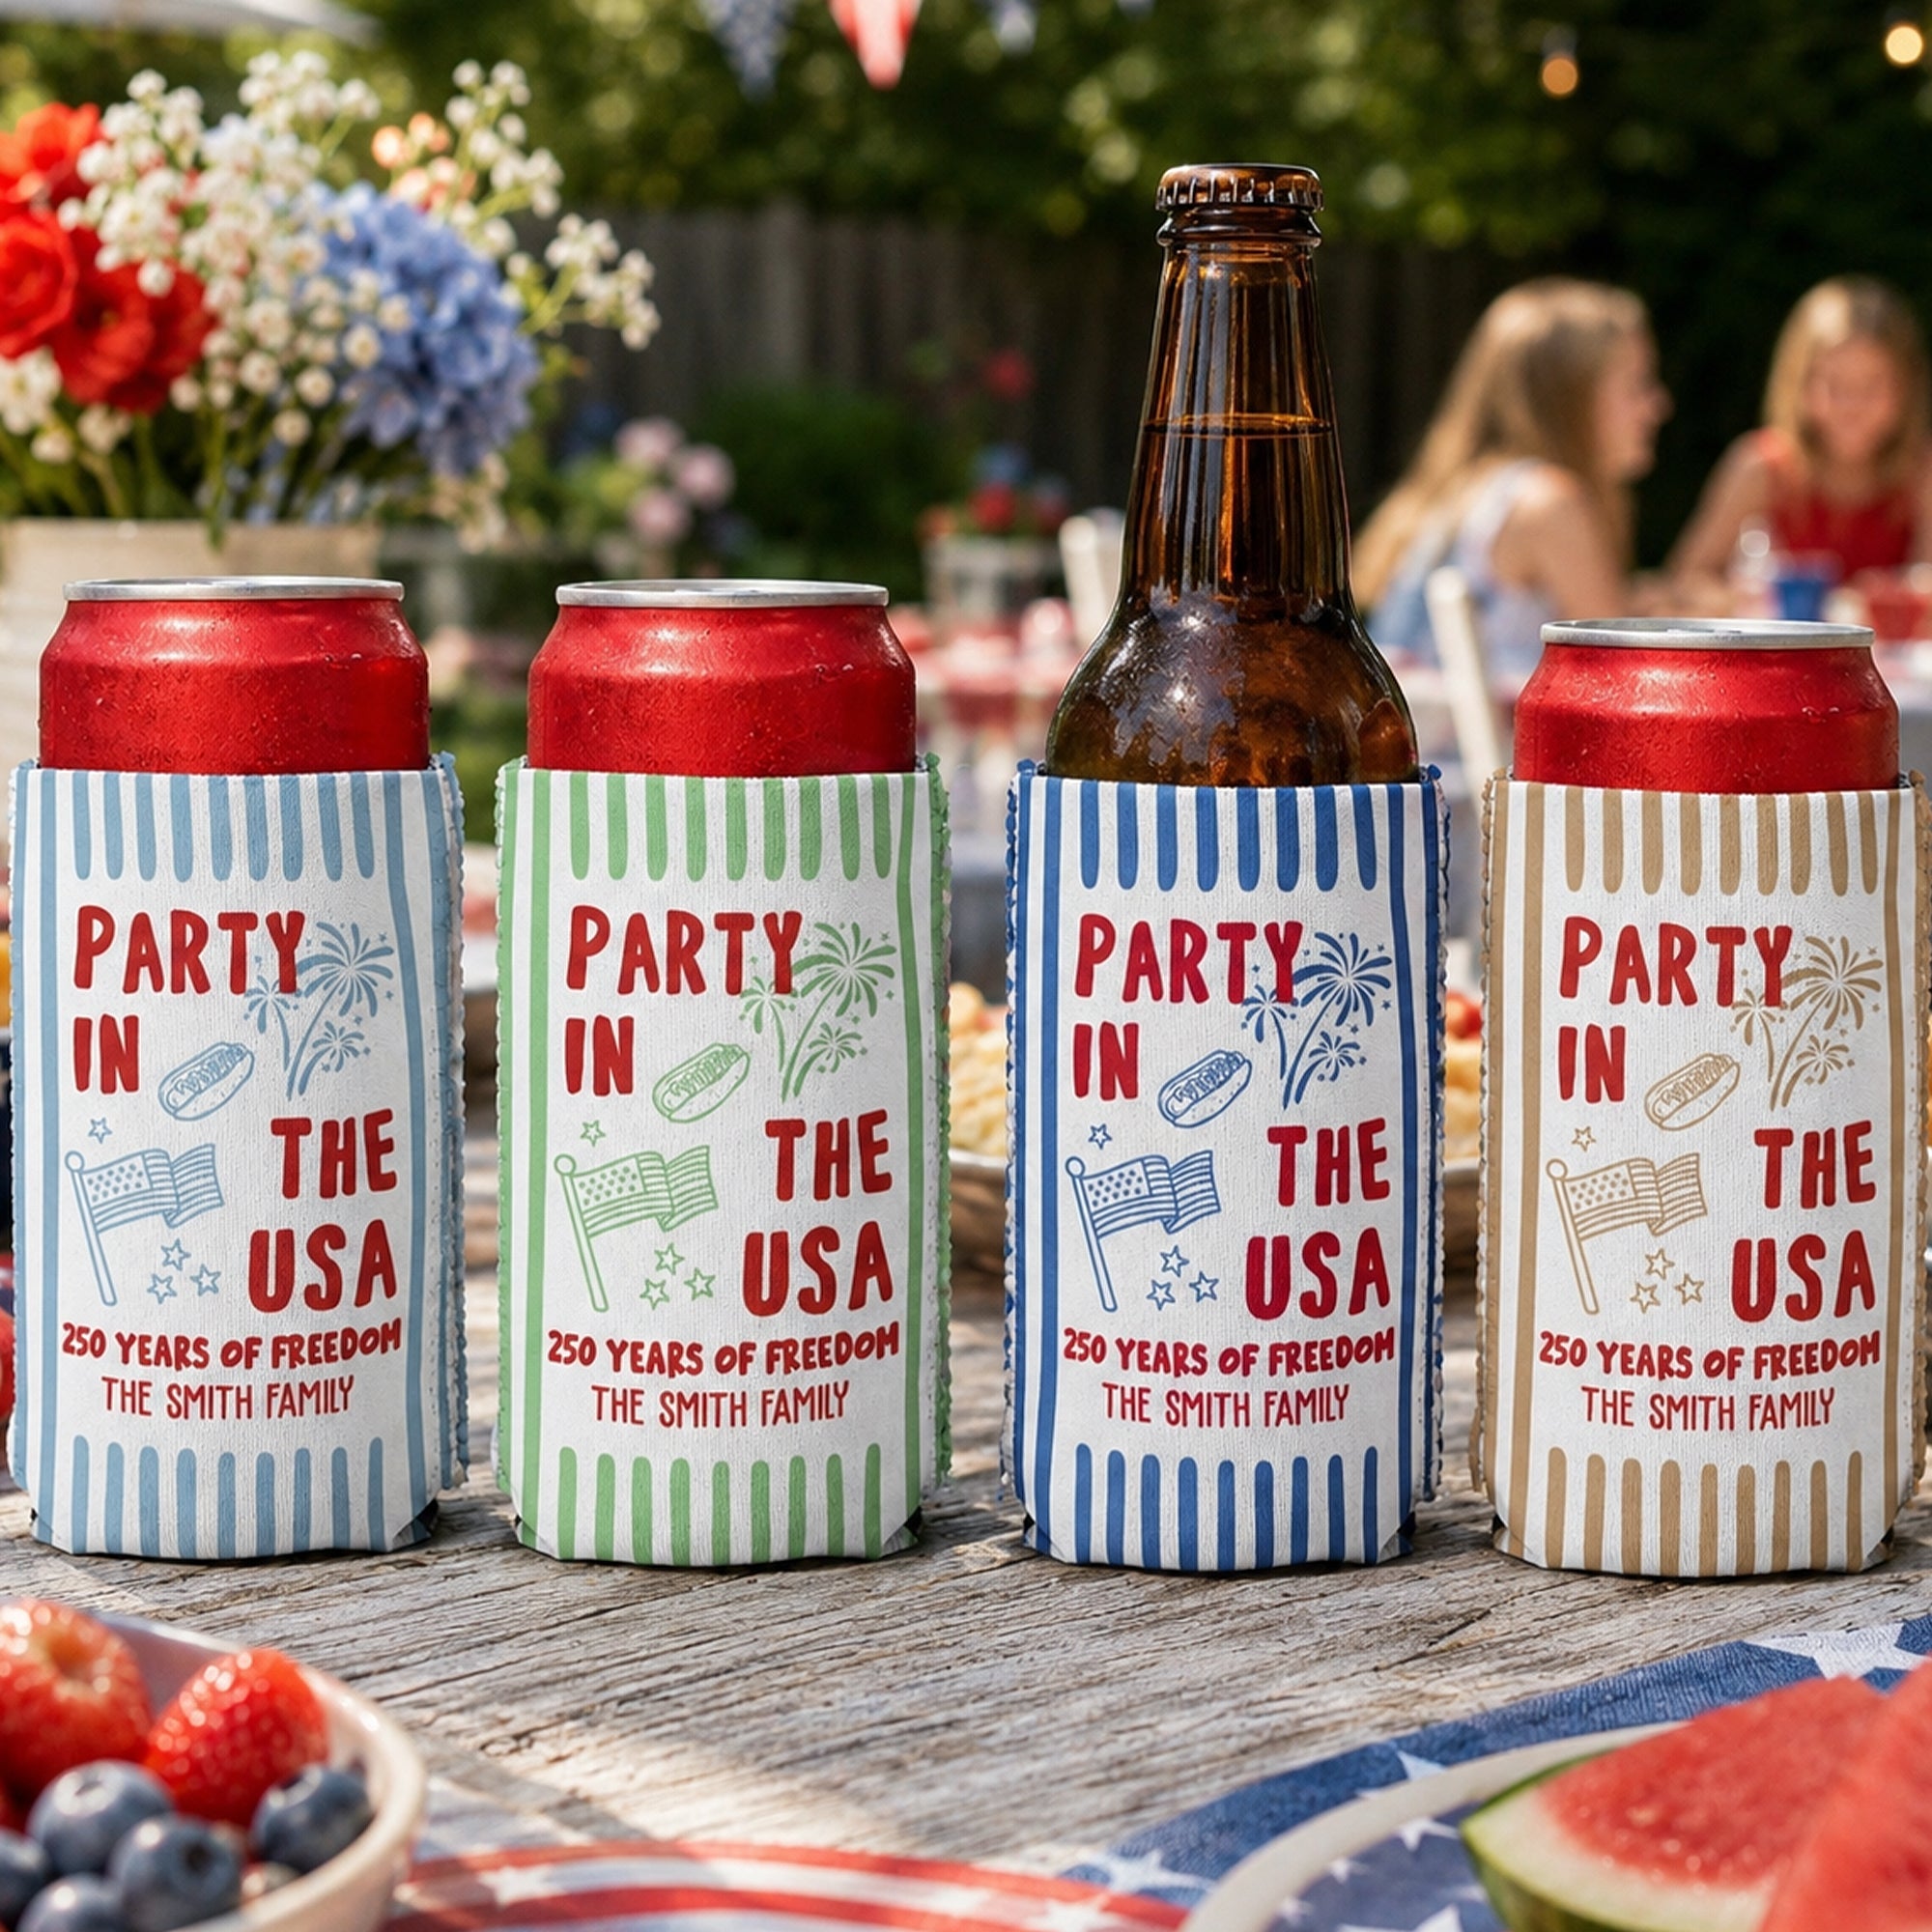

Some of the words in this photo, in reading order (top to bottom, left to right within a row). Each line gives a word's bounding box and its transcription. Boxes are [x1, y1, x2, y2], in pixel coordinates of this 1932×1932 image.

[73, 905, 305, 995] PARTY
[566, 905, 803, 996] PARTY
[1074, 913, 1303, 1005] PARTY
[1559, 916, 1793, 1009] PARTY
[73, 1013, 139, 1094] IN
[565, 1014, 634, 1096] IN
[1073, 1021, 1139, 1101] IN
[1558, 1024, 1626, 1104] IN
[270, 1108, 397, 1200] THE
[765, 1109, 893, 1202] THE
[1267, 1118, 1390, 1208] THE
[1754, 1120, 1876, 1209] THE
[248, 1219, 397, 1313] USA
[743, 1221, 894, 1317] USA
[1245, 1227, 1391, 1321] USA
[1731, 1230, 1876, 1323] USA
[63, 1322, 106, 1358] 250
[115, 1332, 210, 1371] YEARS
[220, 1336, 263, 1370] OF
[271, 1318, 402, 1369] FREEDOM
[548, 1330, 597, 1366] 250
[606, 1339, 703, 1378] YEARS
[715, 1342, 756, 1376] OF
[766, 1321, 899, 1375] FREEDOM
[1064, 1327, 1107, 1364] 250
[1115, 1338, 1208, 1378] YEARS
[1218, 1343, 1260, 1378] OF
[1268, 1326, 1395, 1377] FREEDOM
[1540, 1331, 1587, 1367] 250
[1596, 1341, 1692, 1381] YEARS
[1703, 1347, 1745, 1380] OF
[1753, 1330, 1880, 1380] FREEDOM
[101, 1377, 152, 1416] THE
[167, 1383, 252, 1419] SMITH
[267, 1376, 354, 1419] FAMILY
[591, 1385, 644, 1425] THE
[659, 1391, 747, 1428] SMITH
[761, 1380, 849, 1426] FAMILY
[1102, 1382, 1151, 1423] THE
[1165, 1389, 1250, 1428] SMITH
[1264, 1385, 1350, 1428] FAMILY
[1581, 1386, 1634, 1427] THE
[1649, 1393, 1735, 1431] SMITH
[1749, 1387, 1834, 1431] FAMILY
